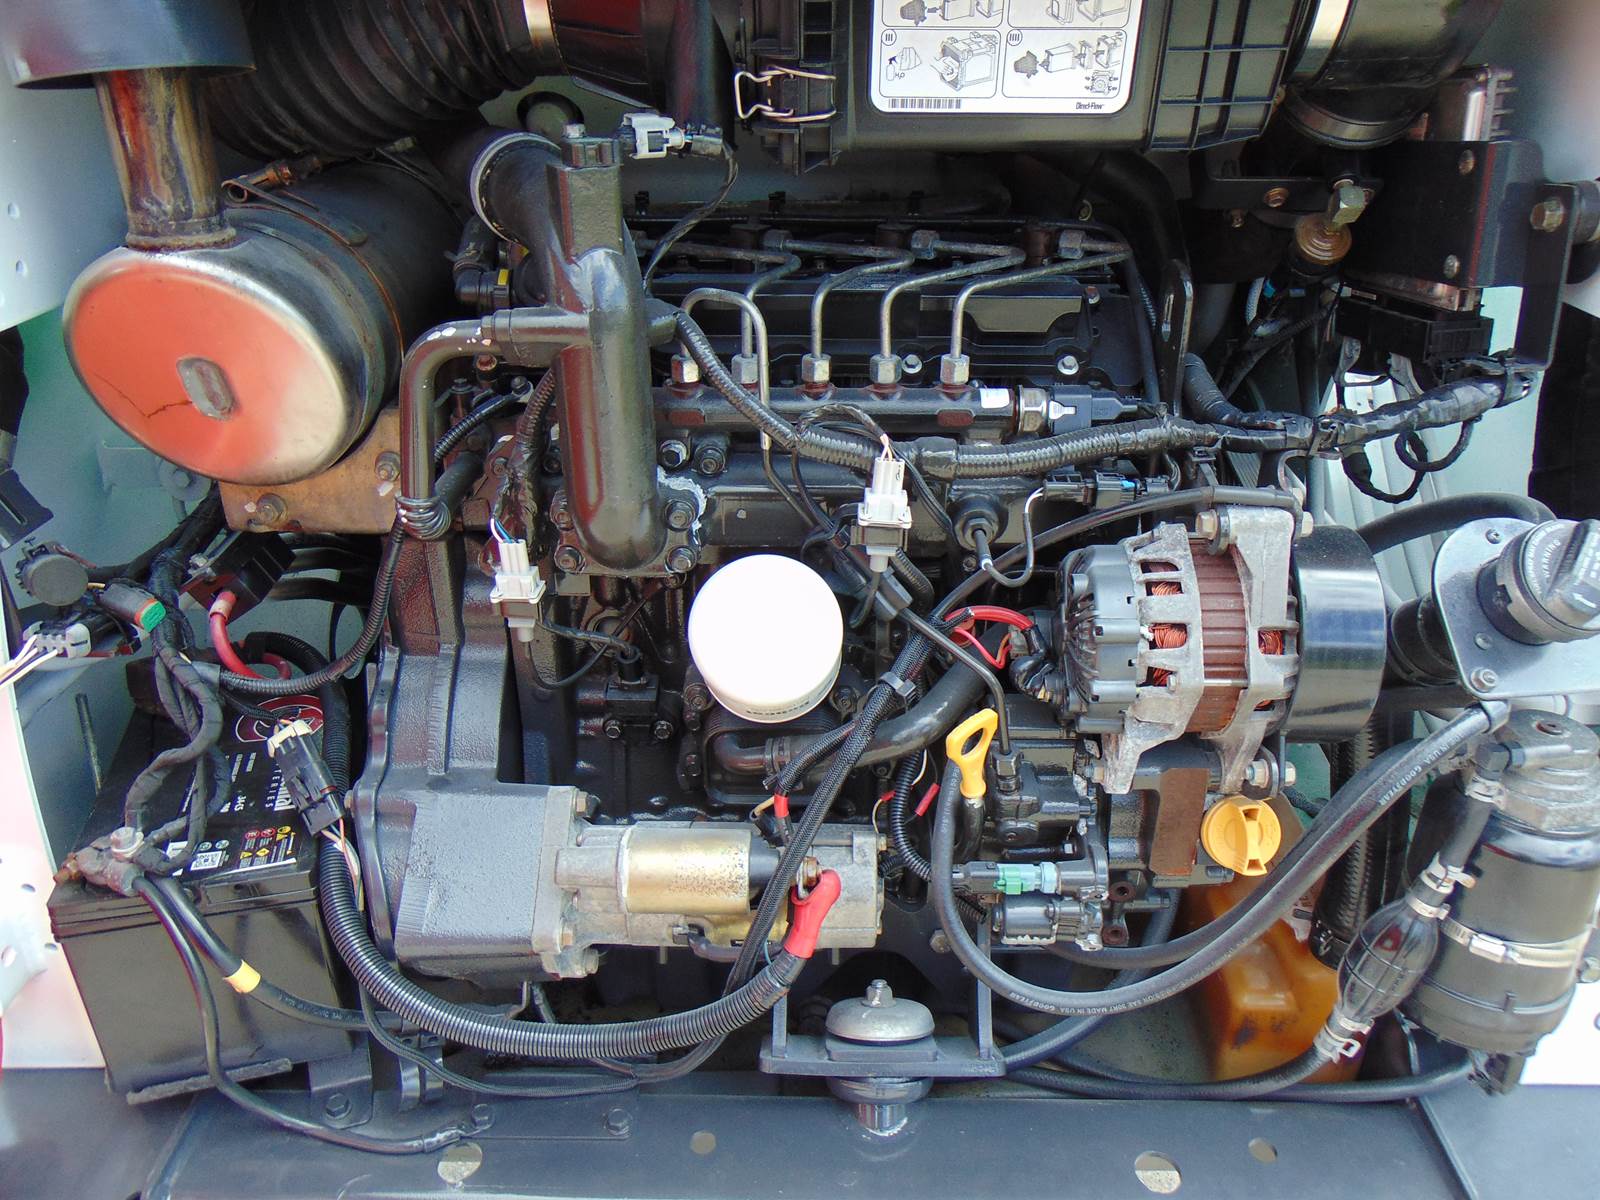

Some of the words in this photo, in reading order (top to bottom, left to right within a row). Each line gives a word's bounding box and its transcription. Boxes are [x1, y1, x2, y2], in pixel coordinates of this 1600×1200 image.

[1541, 539, 1562, 578] WARNING
[1423, 749, 1441, 765] USA
[265, 763, 282, 808] TERIES
[1379, 765, 1422, 806] GOODYEAR
[1009, 991, 1056, 1012] GOODYEAR
[1086, 1006, 1107, 1014] MADE
